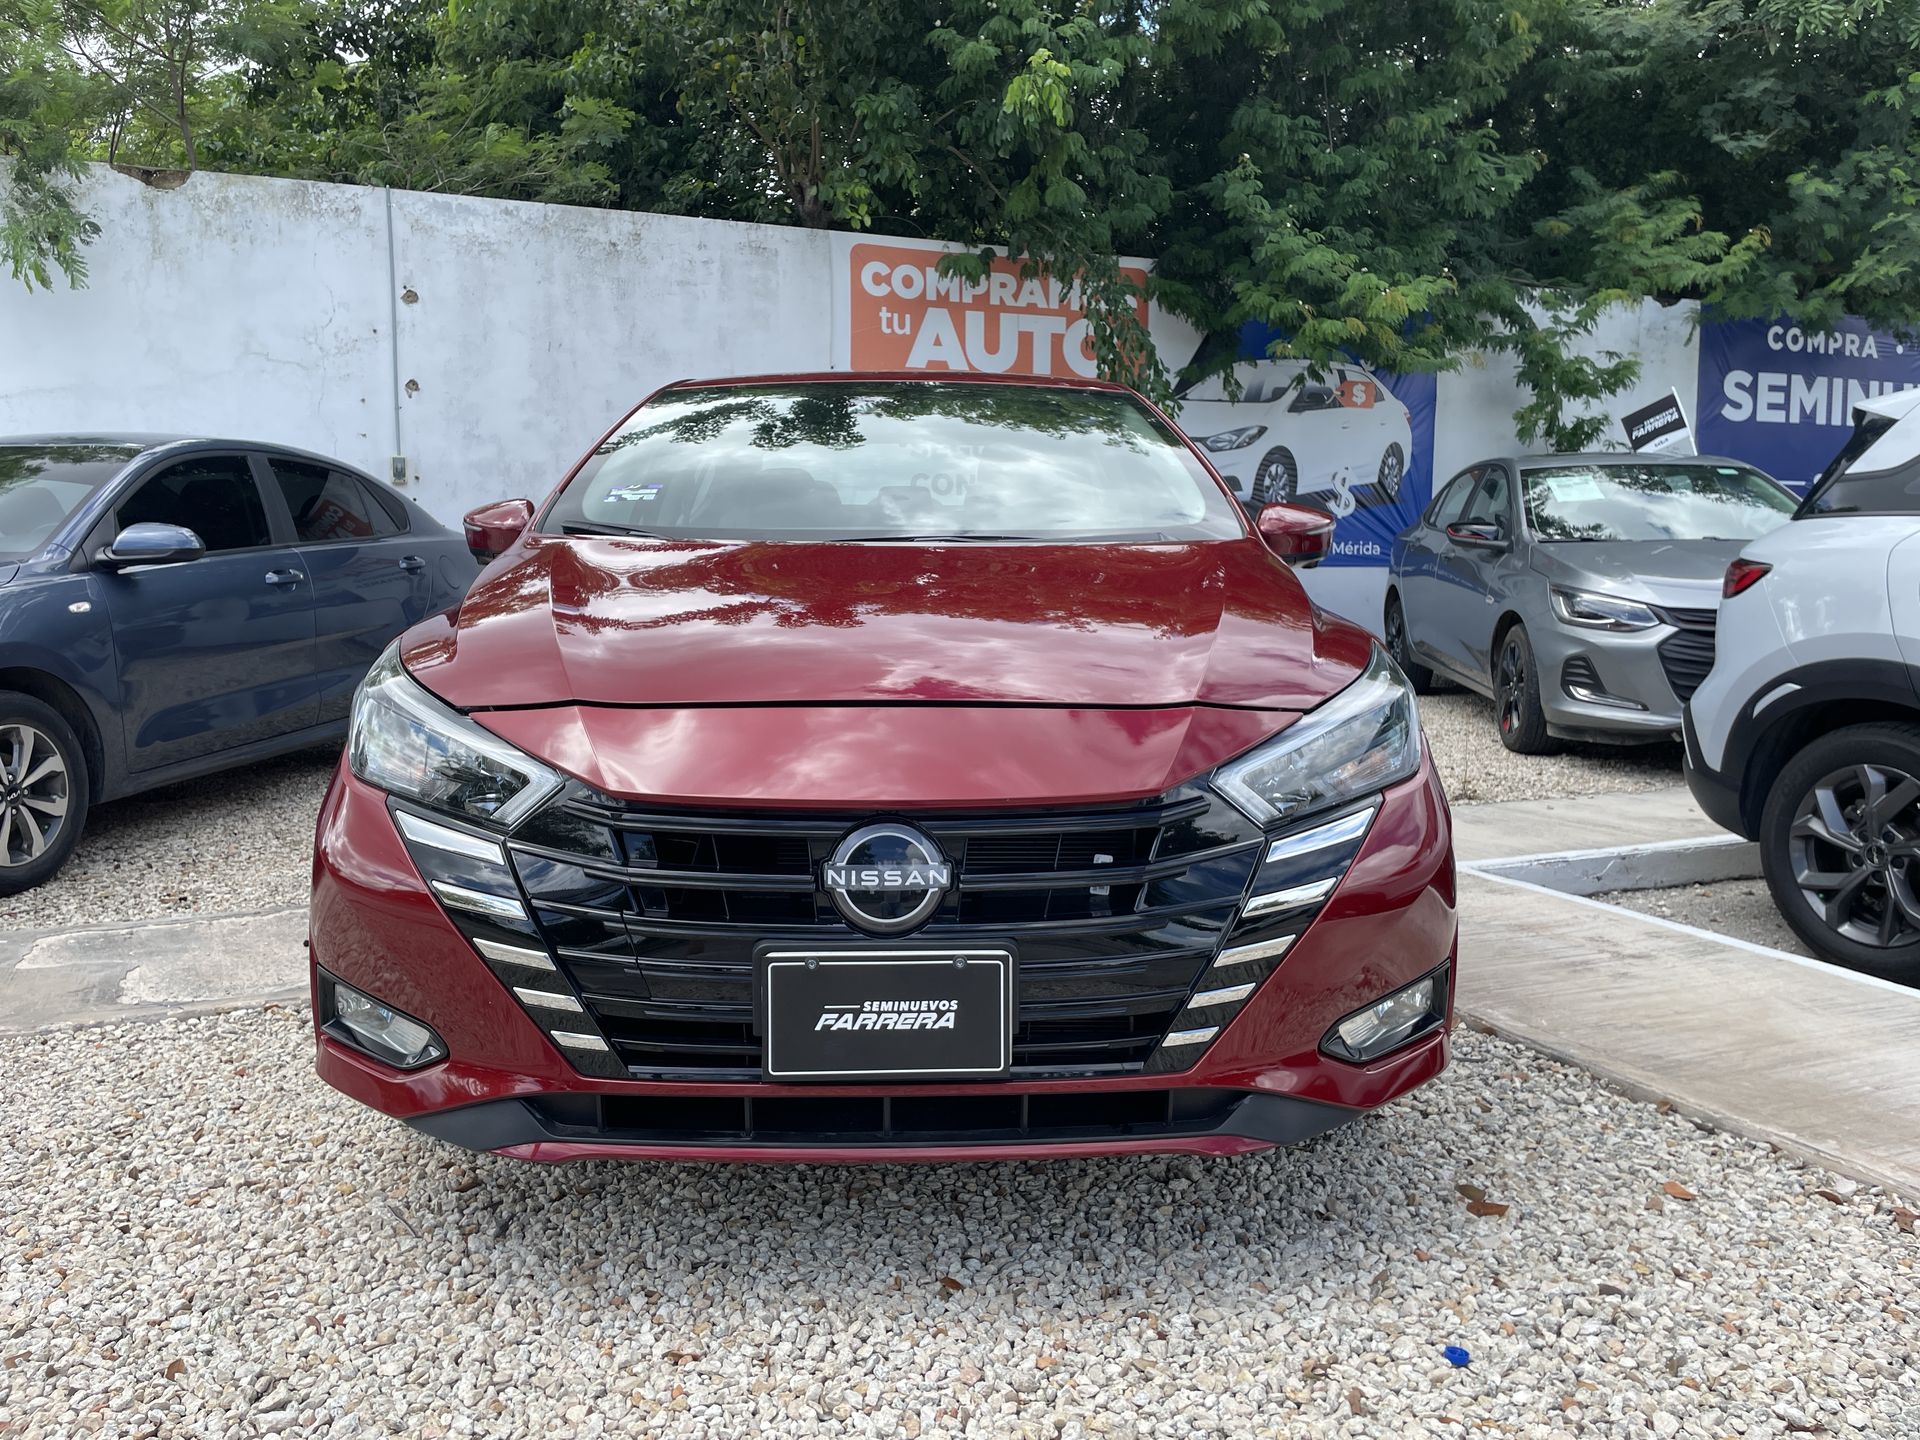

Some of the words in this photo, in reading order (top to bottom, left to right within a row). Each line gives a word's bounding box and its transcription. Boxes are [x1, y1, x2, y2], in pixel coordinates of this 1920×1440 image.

[861, 261, 1137, 311] COMPRAM
[879, 306, 911, 335] tu
[1767, 325, 1878, 359] COMPRA
[1721, 370, 1920, 427] SEMIN
[1332, 541, 1380, 555] Mérida
[827, 868, 948, 886] NISSAN
[863, 1000, 958, 1011] SEMINUEVOS
[814, 1011, 956, 1031] FARRERA
